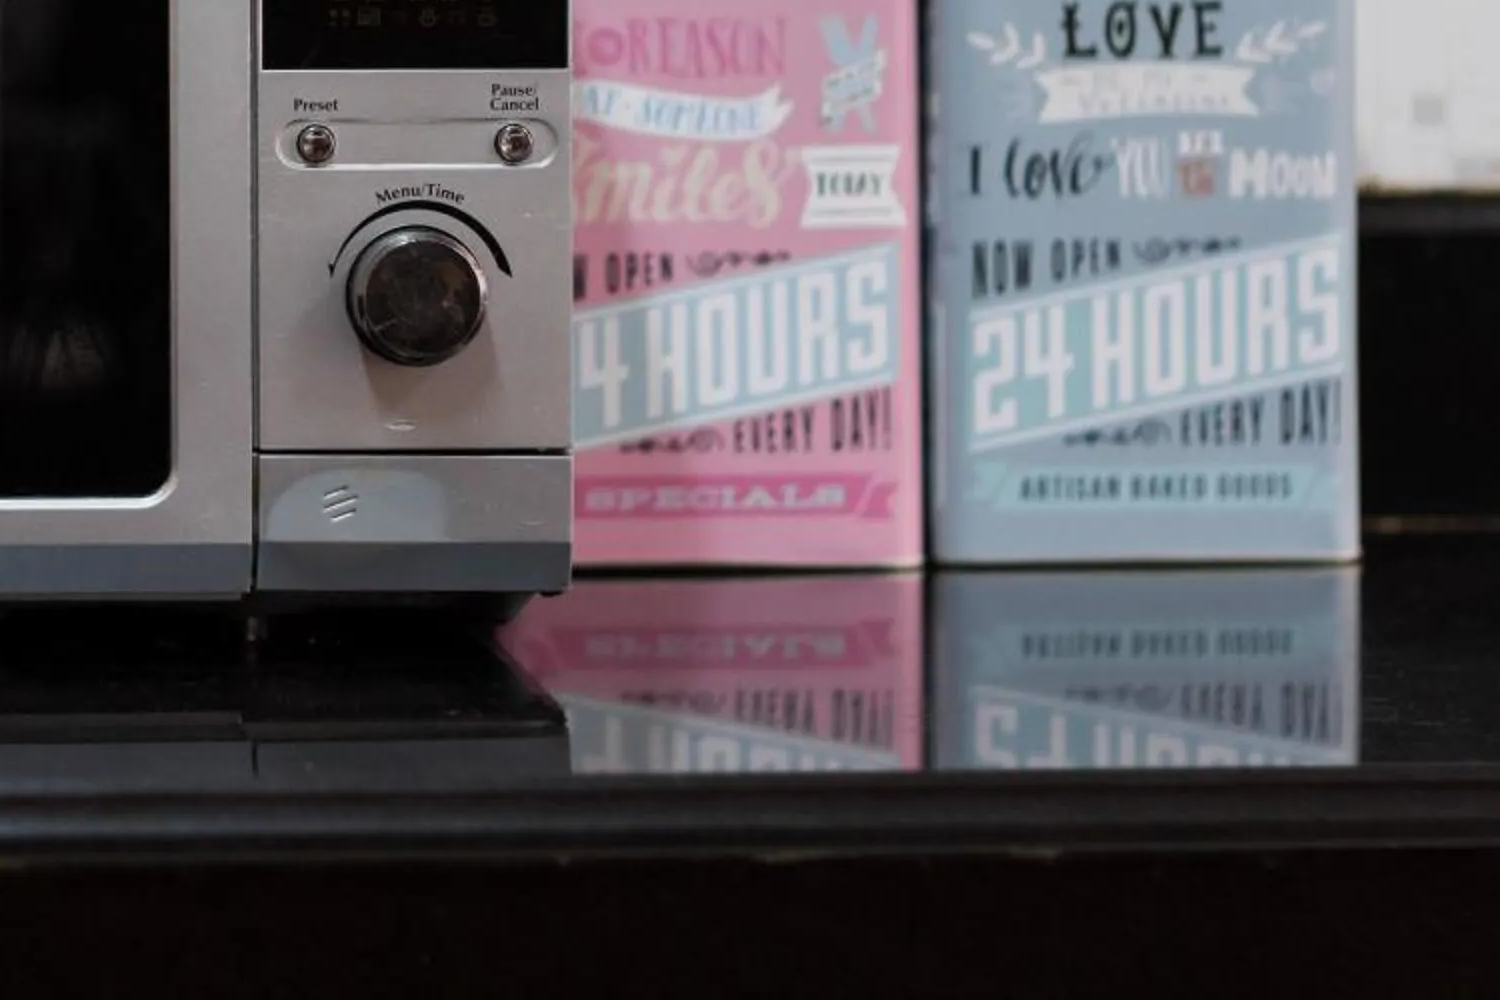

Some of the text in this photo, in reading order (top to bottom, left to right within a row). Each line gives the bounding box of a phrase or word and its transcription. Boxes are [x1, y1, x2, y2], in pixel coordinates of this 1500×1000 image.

[293, 98, 339, 112] Preset
[489, 98, 540, 112] Cancel
[491, 84, 537, 97] Pause/
[374, 183, 465, 205] Menu/Time
[969, 144, 982, 198] I
[605, 251, 673, 295] OPEN
[971, 236, 1121, 299] NOW OPEN
[578, 260, 889, 428] 4 HOURS
[973, 246, 1340, 435] 24 HOURS
[732, 384, 893, 454] EVERY DAY!
[1181, 376, 1343, 448] EVERY DAY!
